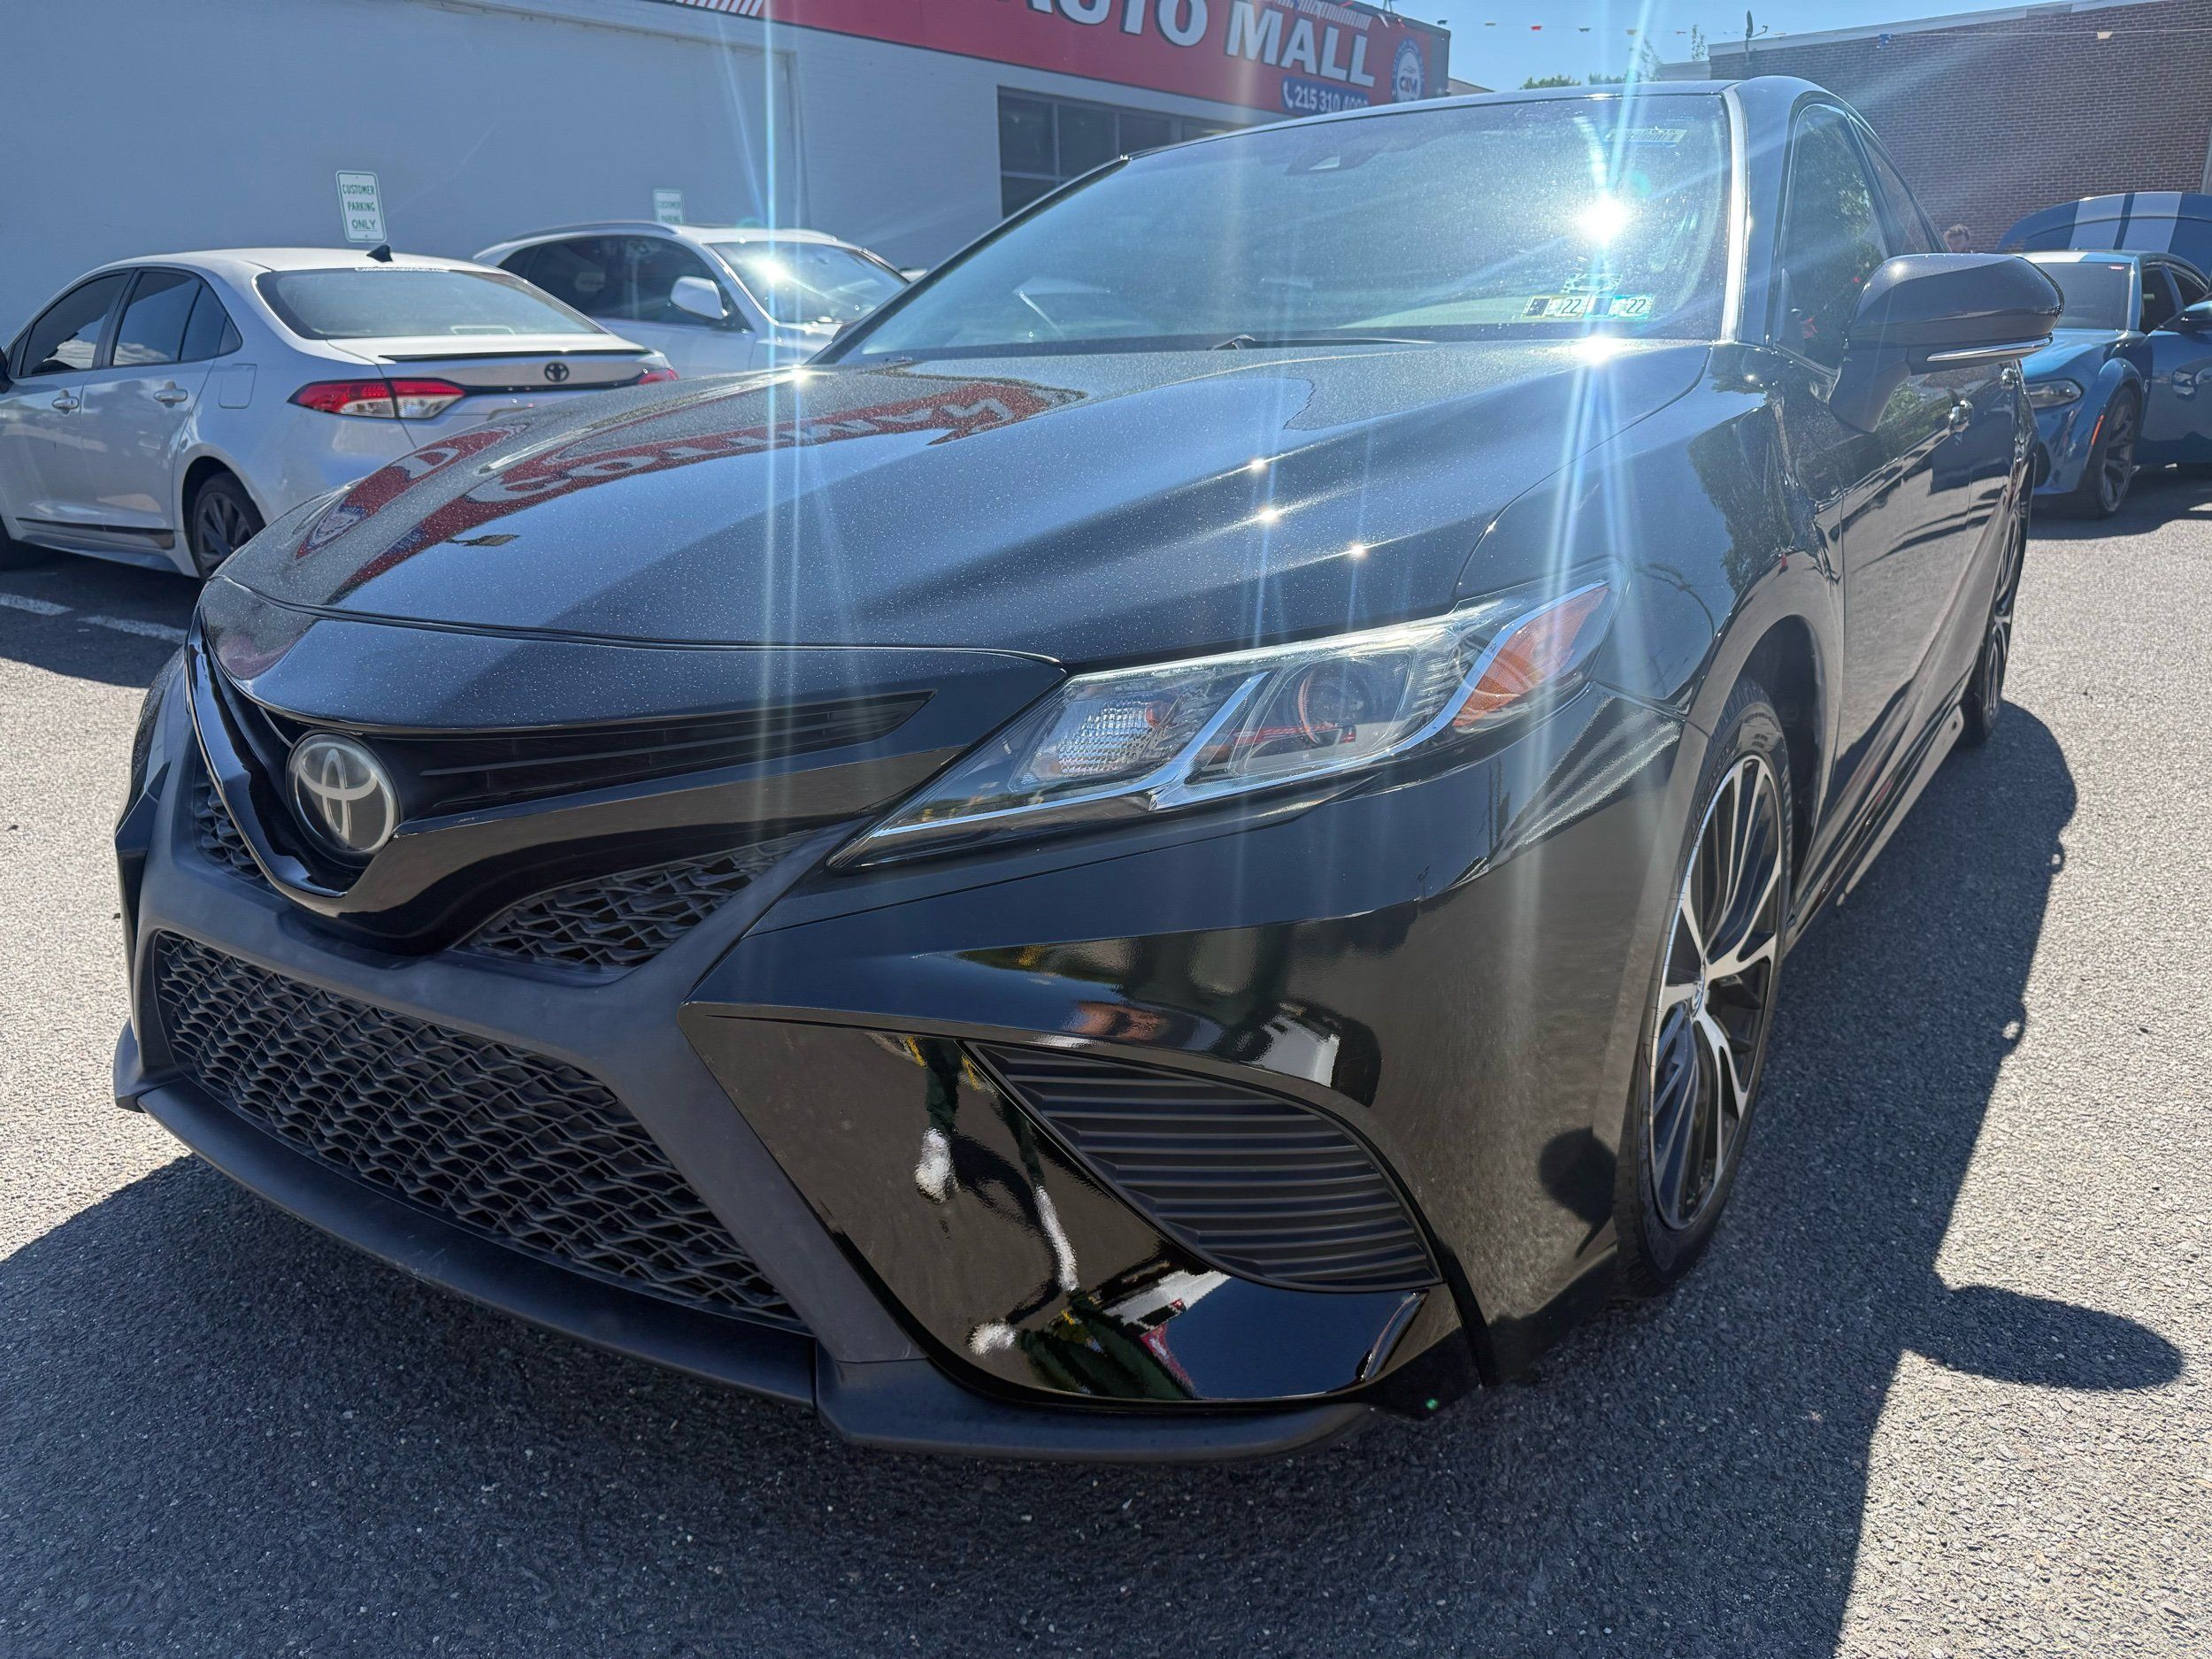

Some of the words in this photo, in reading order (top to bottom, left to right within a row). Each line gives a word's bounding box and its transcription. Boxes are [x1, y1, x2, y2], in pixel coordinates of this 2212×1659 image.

[1026, 0, 1209, 47] TO
[1226, 0, 1376, 87] MALL
[1294, 85, 1317, 111] 215
[1318, 89, 1340, 113] 310
[342, 183, 375, 196] CUSTOMER
[347, 201, 376, 212] PARKING
[351, 219, 376, 230] ONLY
[1561, 298, 1582, 314] 22
[1625, 298, 1647, 314] 22
